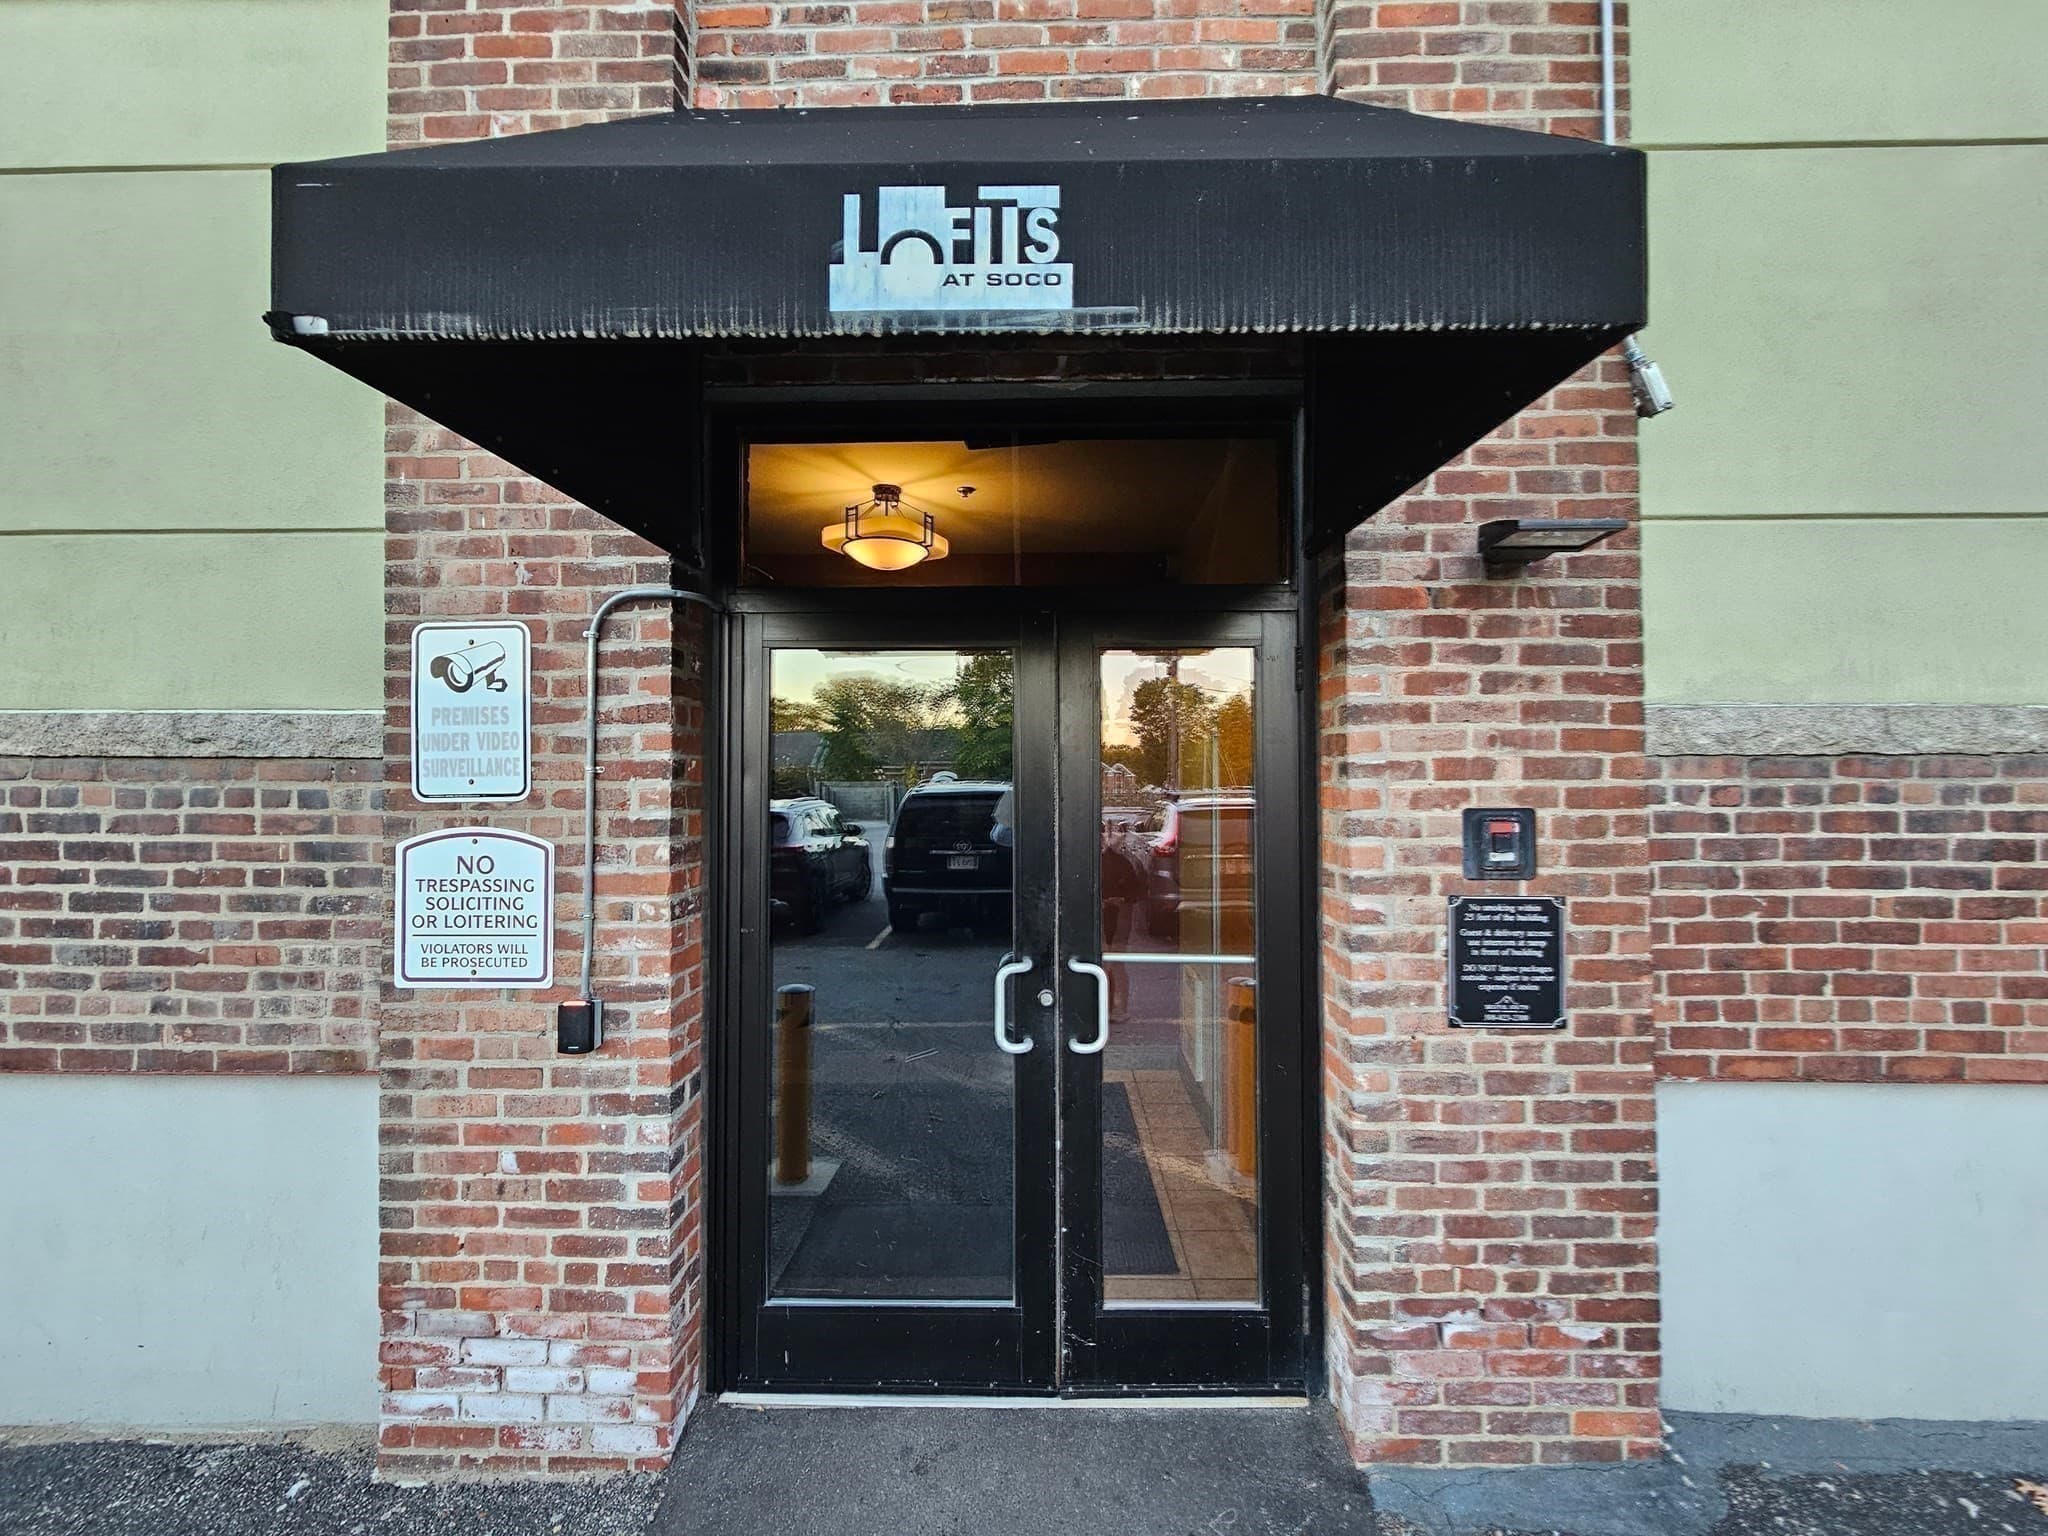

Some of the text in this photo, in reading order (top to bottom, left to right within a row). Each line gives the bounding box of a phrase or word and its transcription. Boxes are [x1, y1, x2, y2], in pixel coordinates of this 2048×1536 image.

[942, 273, 1061, 287] AT SOCO
[431, 706, 510, 726] PREMISES
[423, 731, 520, 752] UNDER VIDEO
[423, 757, 520, 778] SURVEILLANCE
[457, 855, 495, 875] NO
[415, 879, 535, 893] TRESPASSING
[425, 897, 524, 911] SOLICITING
[1468, 904, 1542, 913] No smoking within
[411, 915, 538, 929] OR LOITERING
[1516, 914, 1549, 923] building
[1459, 928, 1482, 937] Guest
[1493, 929, 1525, 938] delivery
[421, 943, 528, 954] VIOLATORS WILL
[1480, 948, 1500, 956] front
[1500, 948, 1511, 956] of
[1511, 948, 1544, 957] building
[421, 957, 528, 968] BE PROSECUTED
[1462, 964, 1553, 974] DO NOT leave packages
